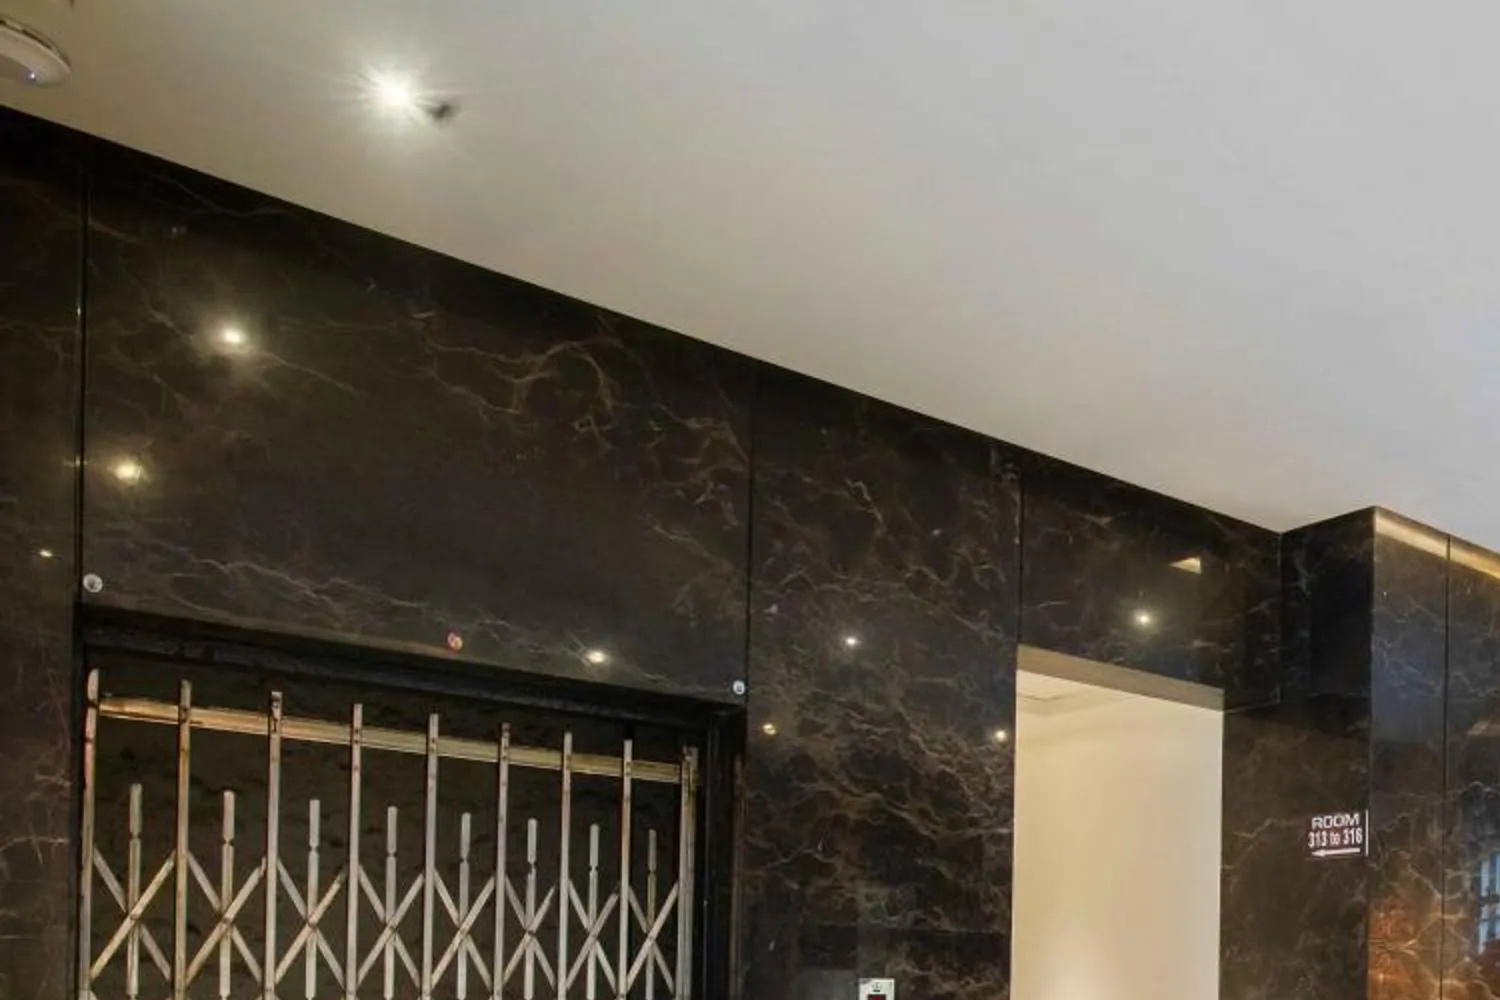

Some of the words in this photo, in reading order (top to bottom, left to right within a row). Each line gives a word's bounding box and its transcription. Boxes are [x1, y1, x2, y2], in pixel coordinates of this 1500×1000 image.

[1311, 813, 1360, 829] ROOM
[1307, 830, 1328, 848] 313
[1330, 831, 1340, 846] to
